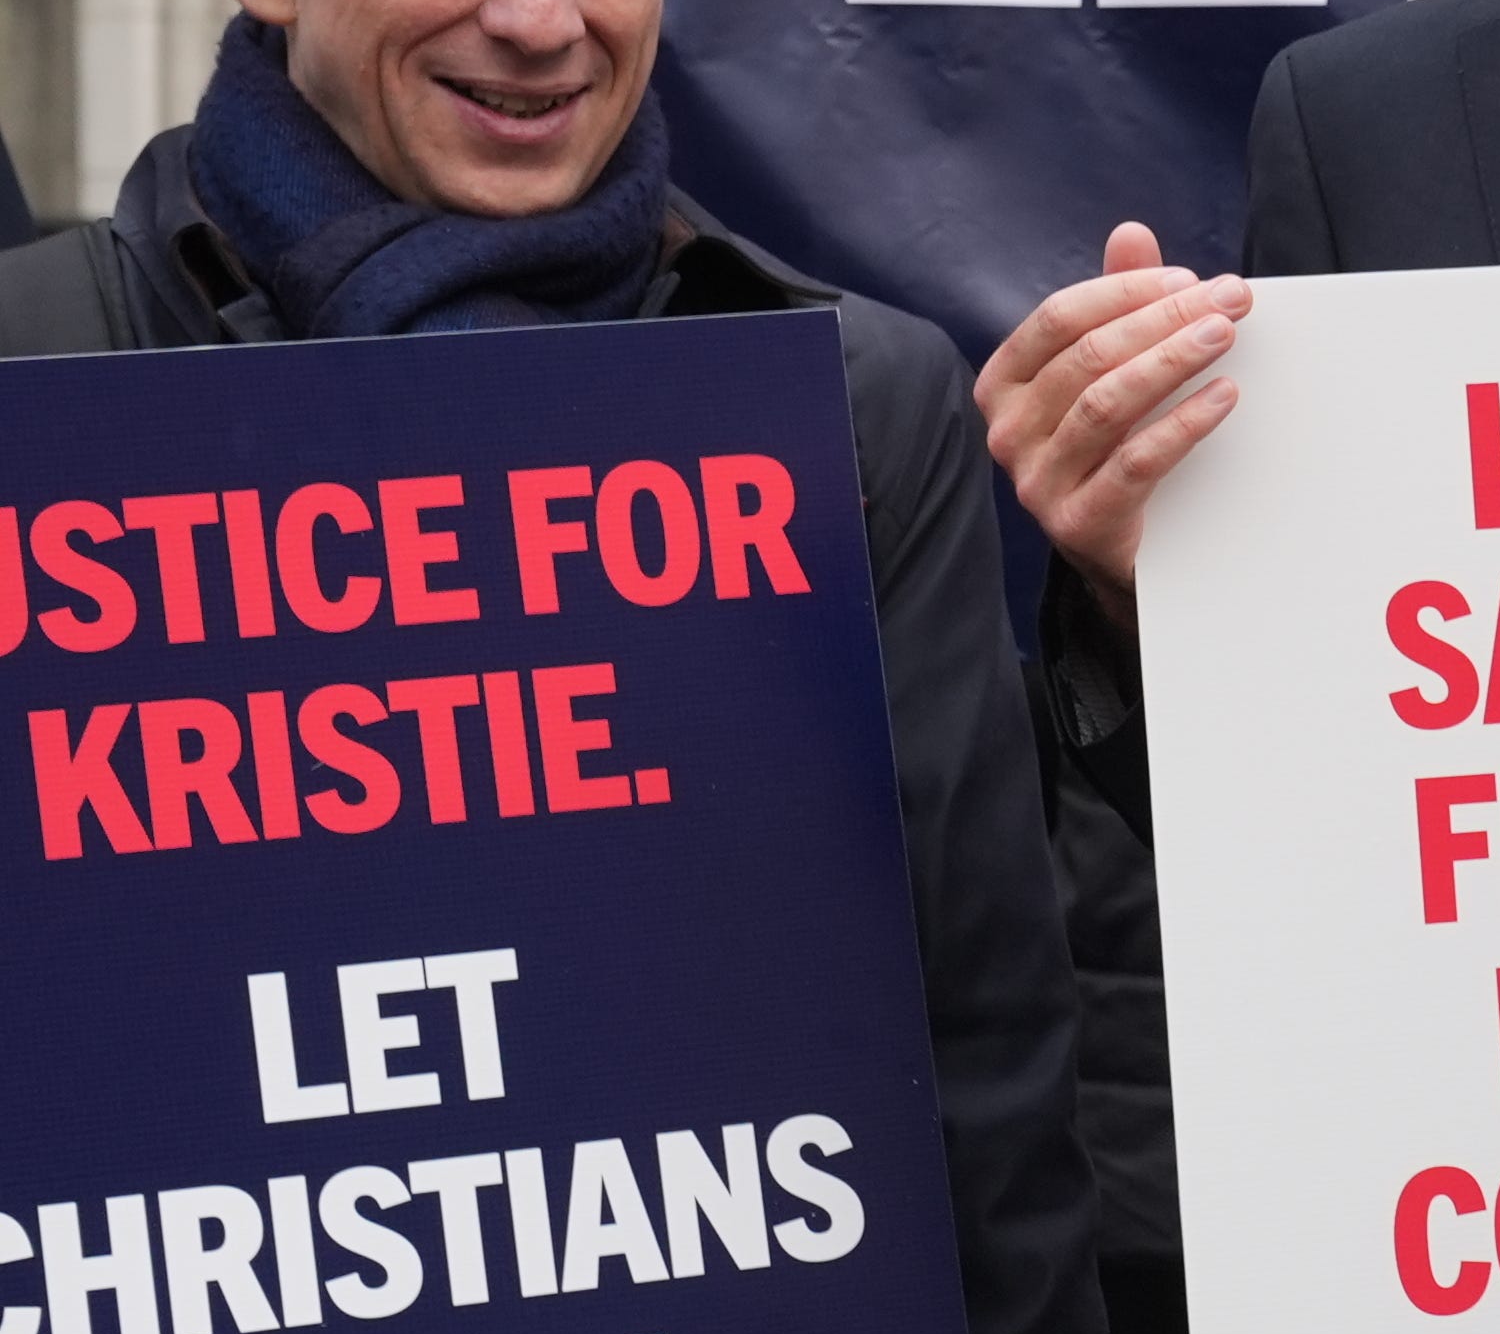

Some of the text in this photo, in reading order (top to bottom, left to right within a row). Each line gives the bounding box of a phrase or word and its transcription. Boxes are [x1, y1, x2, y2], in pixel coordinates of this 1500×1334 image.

[506, 452, 812, 615] FOR
[27, 661, 671, 861] KRISTIE.
[246, 947, 519, 1124] LET
